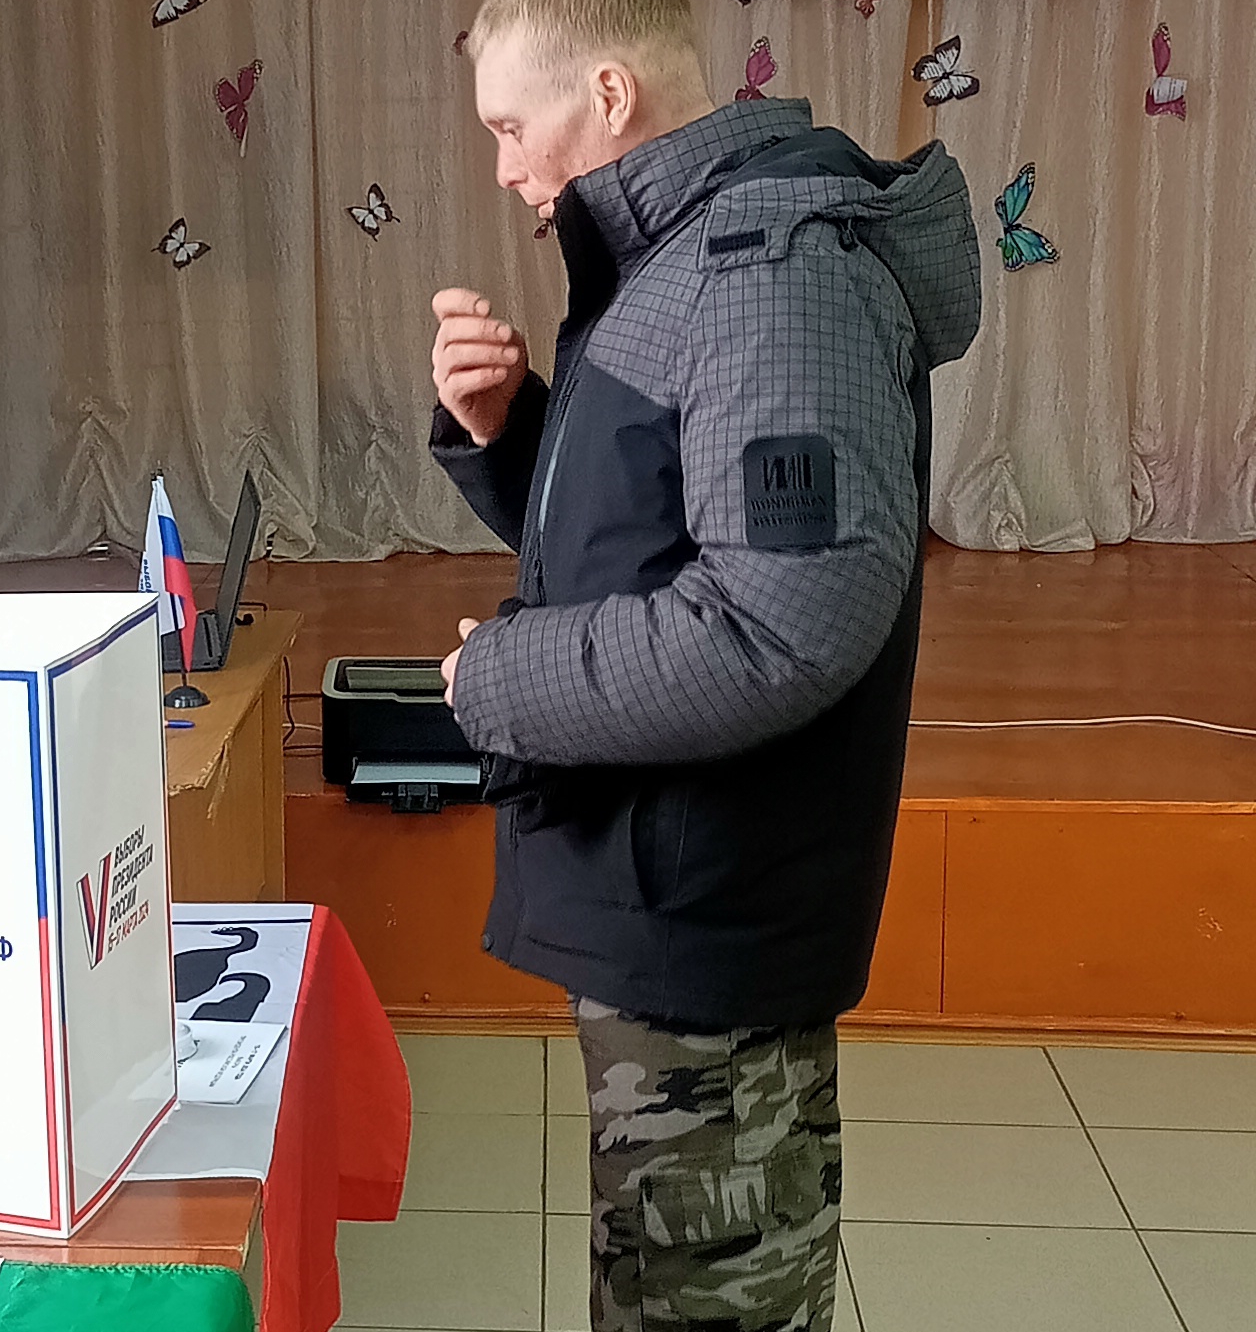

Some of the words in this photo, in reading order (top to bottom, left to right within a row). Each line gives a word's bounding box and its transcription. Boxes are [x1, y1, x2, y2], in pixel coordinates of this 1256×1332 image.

[113, 824, 145, 869] ВЫБОРЫ
[111, 843, 154, 899] ПРЕЗИДЕНТА
[108, 884, 137, 928] РОССИИ
